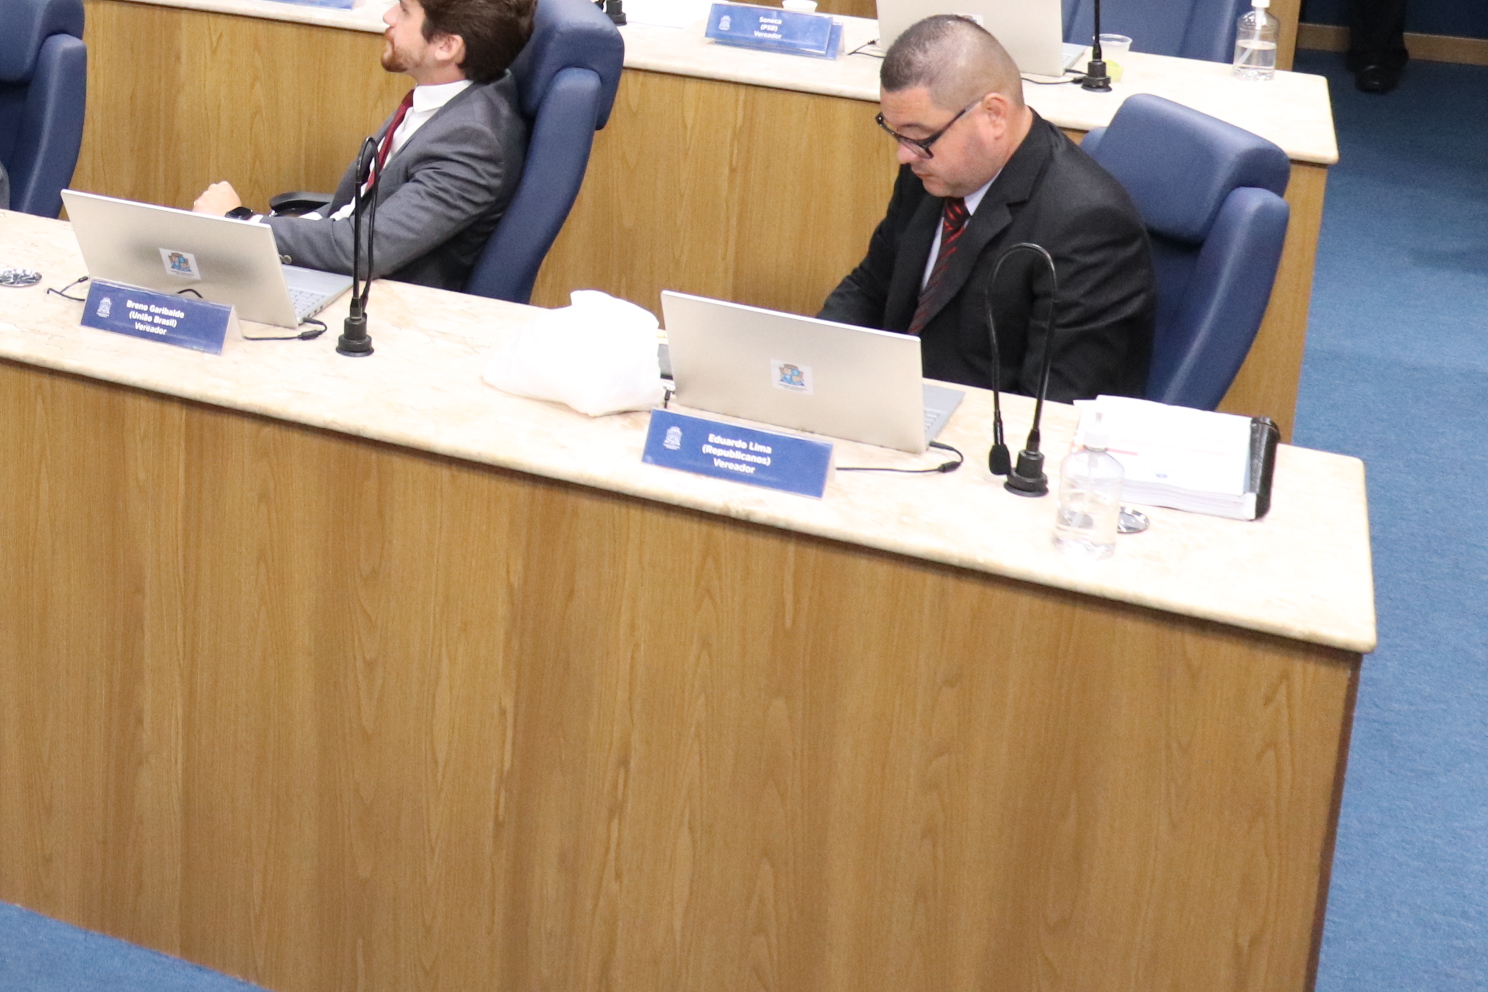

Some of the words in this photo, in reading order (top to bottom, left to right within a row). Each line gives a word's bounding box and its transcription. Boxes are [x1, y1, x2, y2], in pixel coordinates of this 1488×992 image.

[126, 299, 149, 312] Breno
[149, 304, 185, 319] Garibalde
[128, 310, 153, 323] (União
[153, 314, 178, 329] Brasil)
[134, 321, 168, 336] Vereador
[707, 432, 748, 450] Eduardo
[748, 440, 772, 455] Lima
[701, 443, 772, 467] (Republicanos)
[713, 456, 757, 474] Vereador
